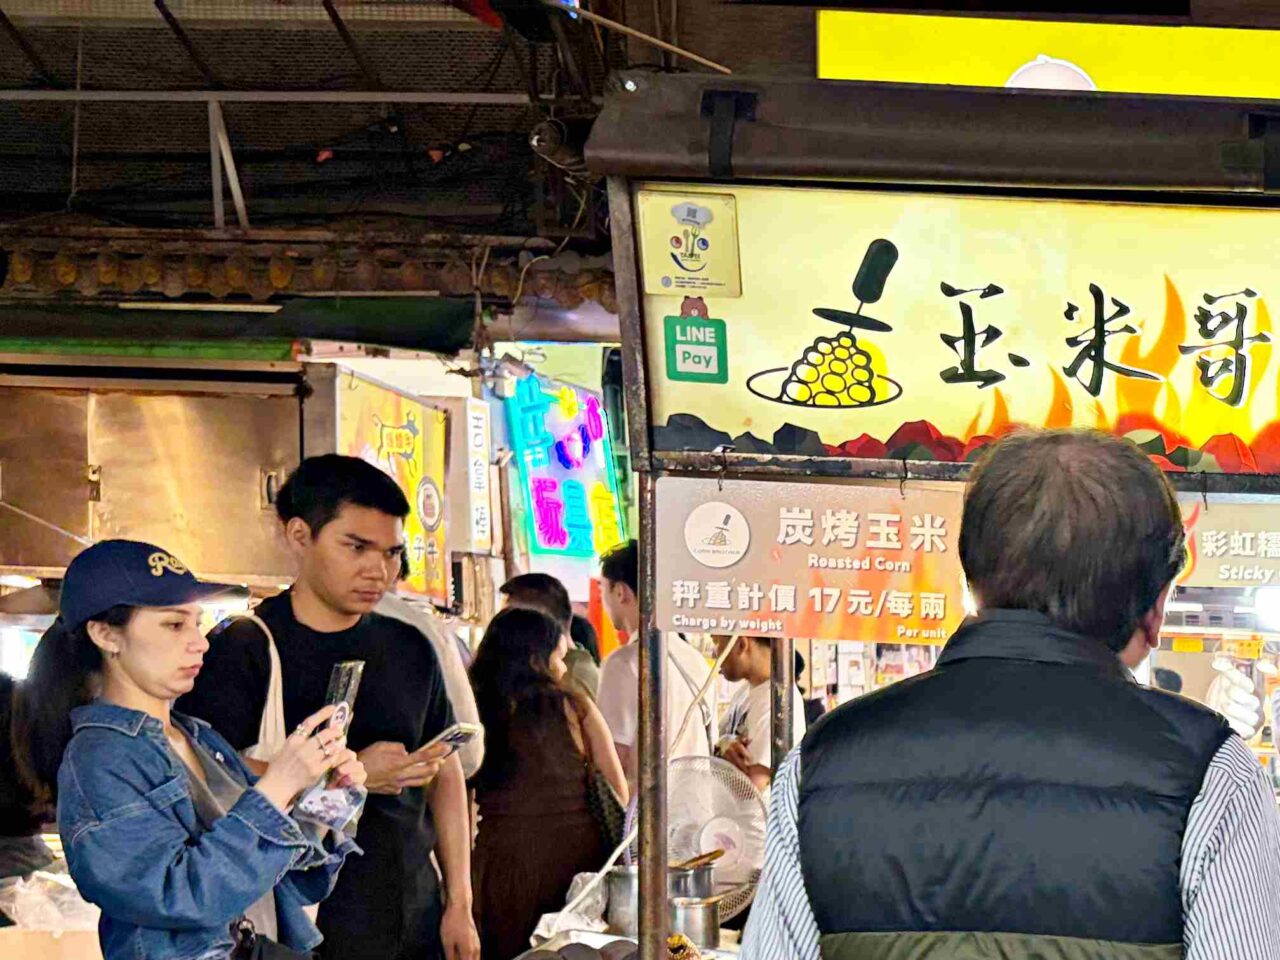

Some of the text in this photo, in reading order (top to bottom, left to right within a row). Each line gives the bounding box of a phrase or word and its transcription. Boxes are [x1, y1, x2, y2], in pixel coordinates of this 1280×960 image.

[676, 325, 716, 343] LINE
[939, 282, 1273, 408] 玉米哥
[682, 351, 713, 368] Pay
[776, 507, 947, 552] 炭烤玉米
[808, 554, 911, 573] Roasted Corn
[1218, 564, 1274, 584] Sticky
[671, 579, 796, 613] 秤重計價
[672, 614, 782, 632] Charge by weight
[897, 624, 946, 640] Per unit
